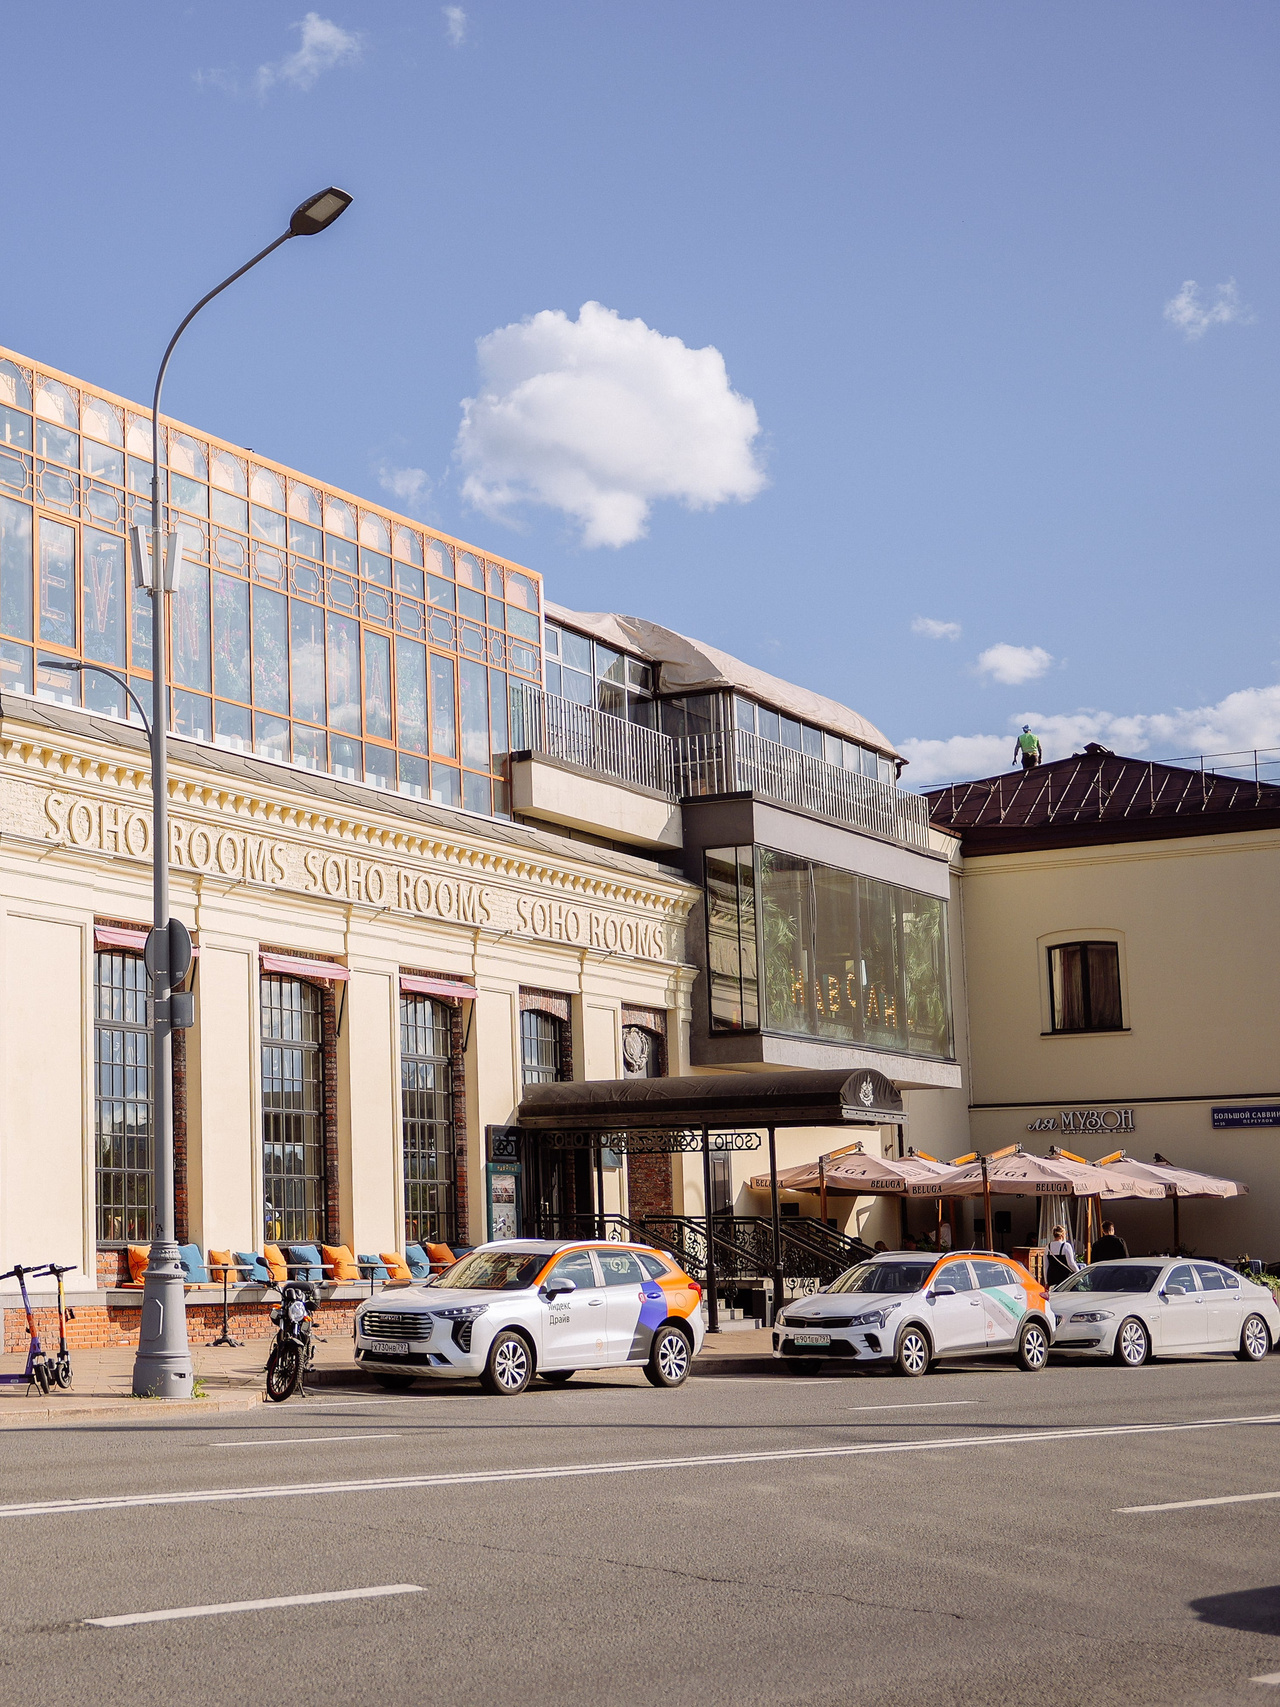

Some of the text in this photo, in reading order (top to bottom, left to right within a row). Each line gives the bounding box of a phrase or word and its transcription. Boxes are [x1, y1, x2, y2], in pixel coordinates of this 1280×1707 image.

[45, 793, 664, 958] SOHO ROOMS SOHO ROOMS SOHO ROOMS
[1060, 1109, 1134, 1130] МУЗОН
[1214, 1111, 1250, 1119] БОЛЬШОЙ
[871, 1180, 901, 1189] BELUGA
[1036, 1183, 1068, 1192] BELUGA
[912, 1185, 942, 1194] BELUGA
[549, 1314, 570, 1325] Драйв
